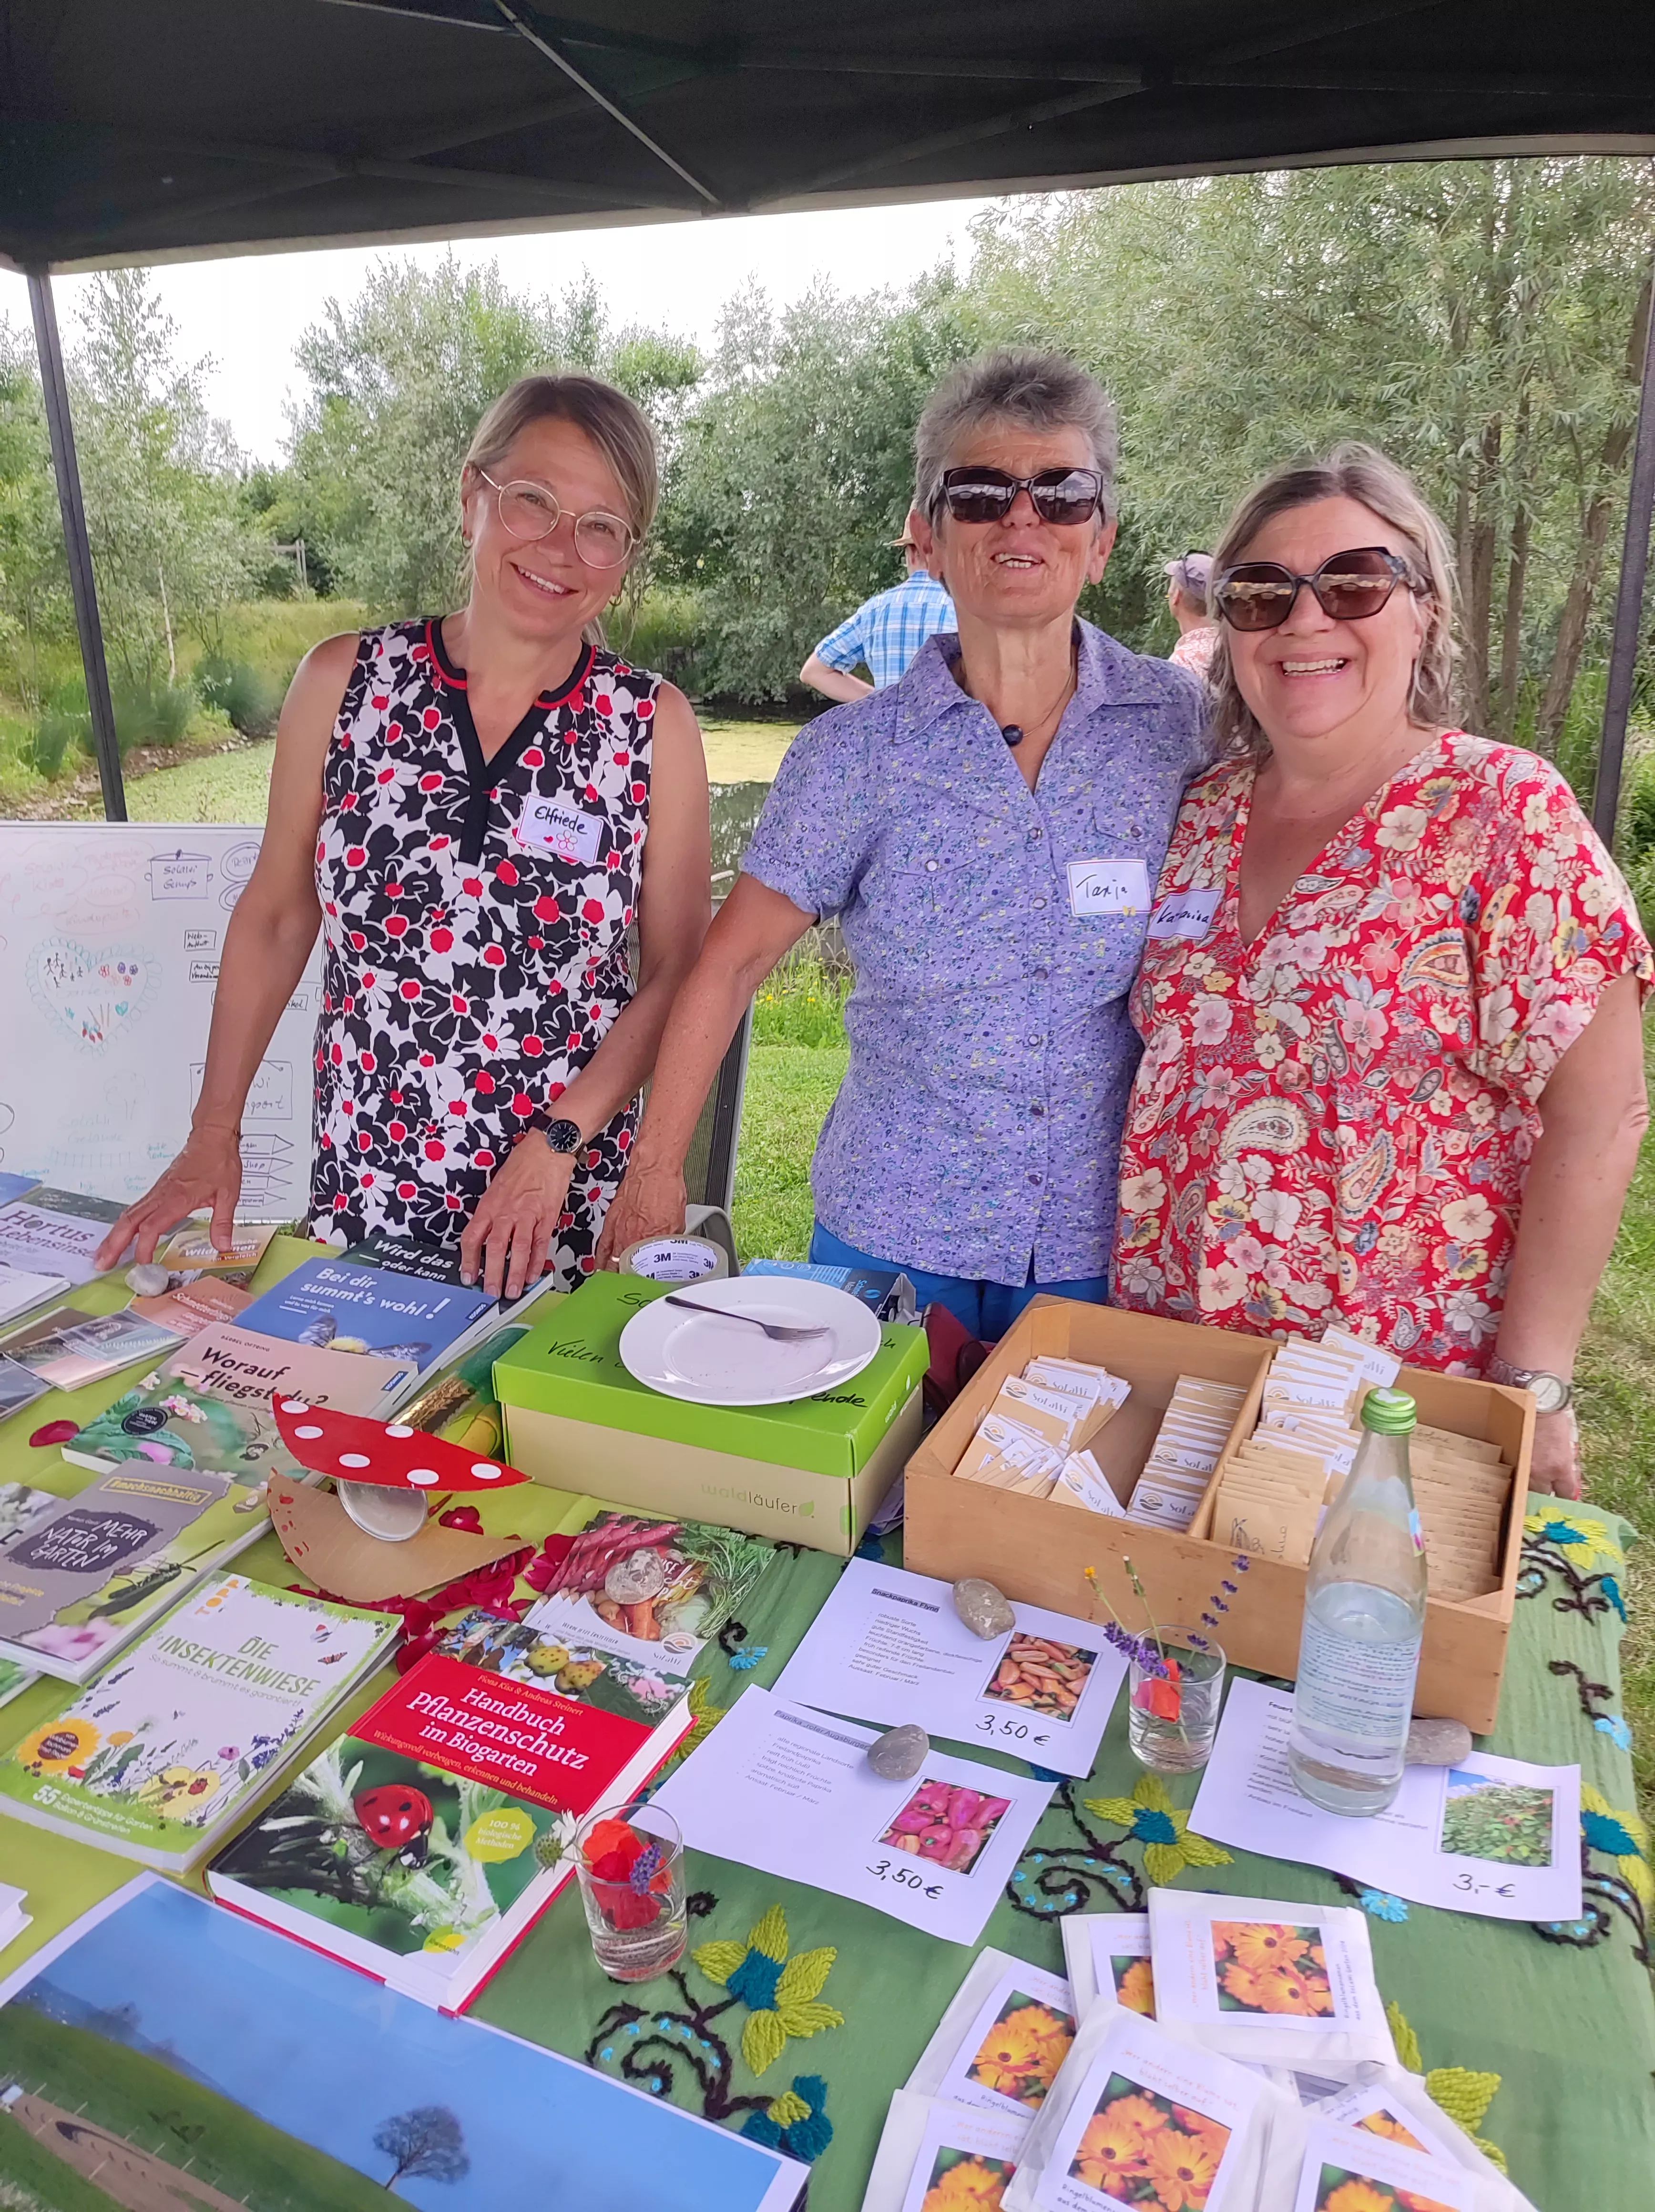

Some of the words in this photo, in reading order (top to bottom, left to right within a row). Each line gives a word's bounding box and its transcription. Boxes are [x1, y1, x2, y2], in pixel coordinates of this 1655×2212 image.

[534, 806, 588, 834] Elfriede
[1076, 874, 1127, 900] Tanja
[0, 1210, 95, 1241] Hortus
[185, 1244, 255, 1257] Wildnen
[374, 1240, 422, 1260] Wird
[420, 1252, 454, 1269] das
[654, 1253, 671, 1263] 3M
[317, 1268, 351, 1283] Bei
[349, 1274, 377, 1288] dir
[381, 1260, 414, 1272] oder
[415, 1266, 446, 1281] kann
[300, 1283, 375, 1305] summt's
[548, 1340, 603, 1362] Vielen
[201, 1347, 291, 1380] Worauf
[200, 1370, 277, 1400] fliegst
[701, 1484, 797, 1514] waldläufer
[40, 1526, 98, 1550] NATUR
[92, 1539, 118, 1559] IM
[92, 1519, 147, 1546] MEHR
[31, 1542, 99, 1567] GARTEN
[194, 1579, 239, 1615] TOPP
[871, 1589, 918, 1607] Snackpaprika
[919, 1602, 940, 1613] Flynn
[875, 1619, 900, 1629] niedriger
[901, 1626, 921, 1635] Wuchs
[878, 1613, 900, 1622] robuste
[900, 1619, 917, 1627] Sorte
[237, 1637, 279, 1660] DIE
[858, 1647, 889, 1660] besonders
[157, 1635, 321, 1697] INSEKTENWIESE
[161, 1658, 194, 1675] summt
[199, 1670, 239, 1690] brummt
[883, 1668, 918, 1679] Geschmack
[478, 1674, 498, 1686] Fiona
[498, 1682, 514, 1692] Kiss
[522, 1690, 553, 1707] Andreas
[555, 1700, 583, 1716] Steinert
[460, 1688, 565, 1736] Handbuch
[774, 1710, 802, 1726] Paprika
[406, 1692, 590, 1770] Pflanzenschutz
[976, 1714, 1028, 1742] 3,50
[419, 1721, 448, 1742] im
[447, 1731, 538, 1777] Biogarten
[767, 1749, 781, 1757] reift
[772, 1742, 821, 1765] Freilandpaprika
[790, 1741, 821, 1756] regionale
[821, 1753, 854, 1769] Landsorte
[374, 1730, 423, 1754] Wirkungsvoll
[463, 1764, 500, 1783] erkennen
[500, 1778, 518, 1789] und
[517, 1783, 559, 1805] behandeln
[751, 1769, 786, 1785] aromatisch
[762, 1755, 777, 1765] trägt
[778, 1762, 806, 1775] reichlich
[806, 1772, 832, 1785] Früchte
[33, 1784, 61, 1805] 55
[807, 1781, 832, 1793] Paprika
[478, 1828, 521, 1840] biologische
[489, 1820, 508, 1828] 100
[476, 1837, 514, 1849] Methoden
